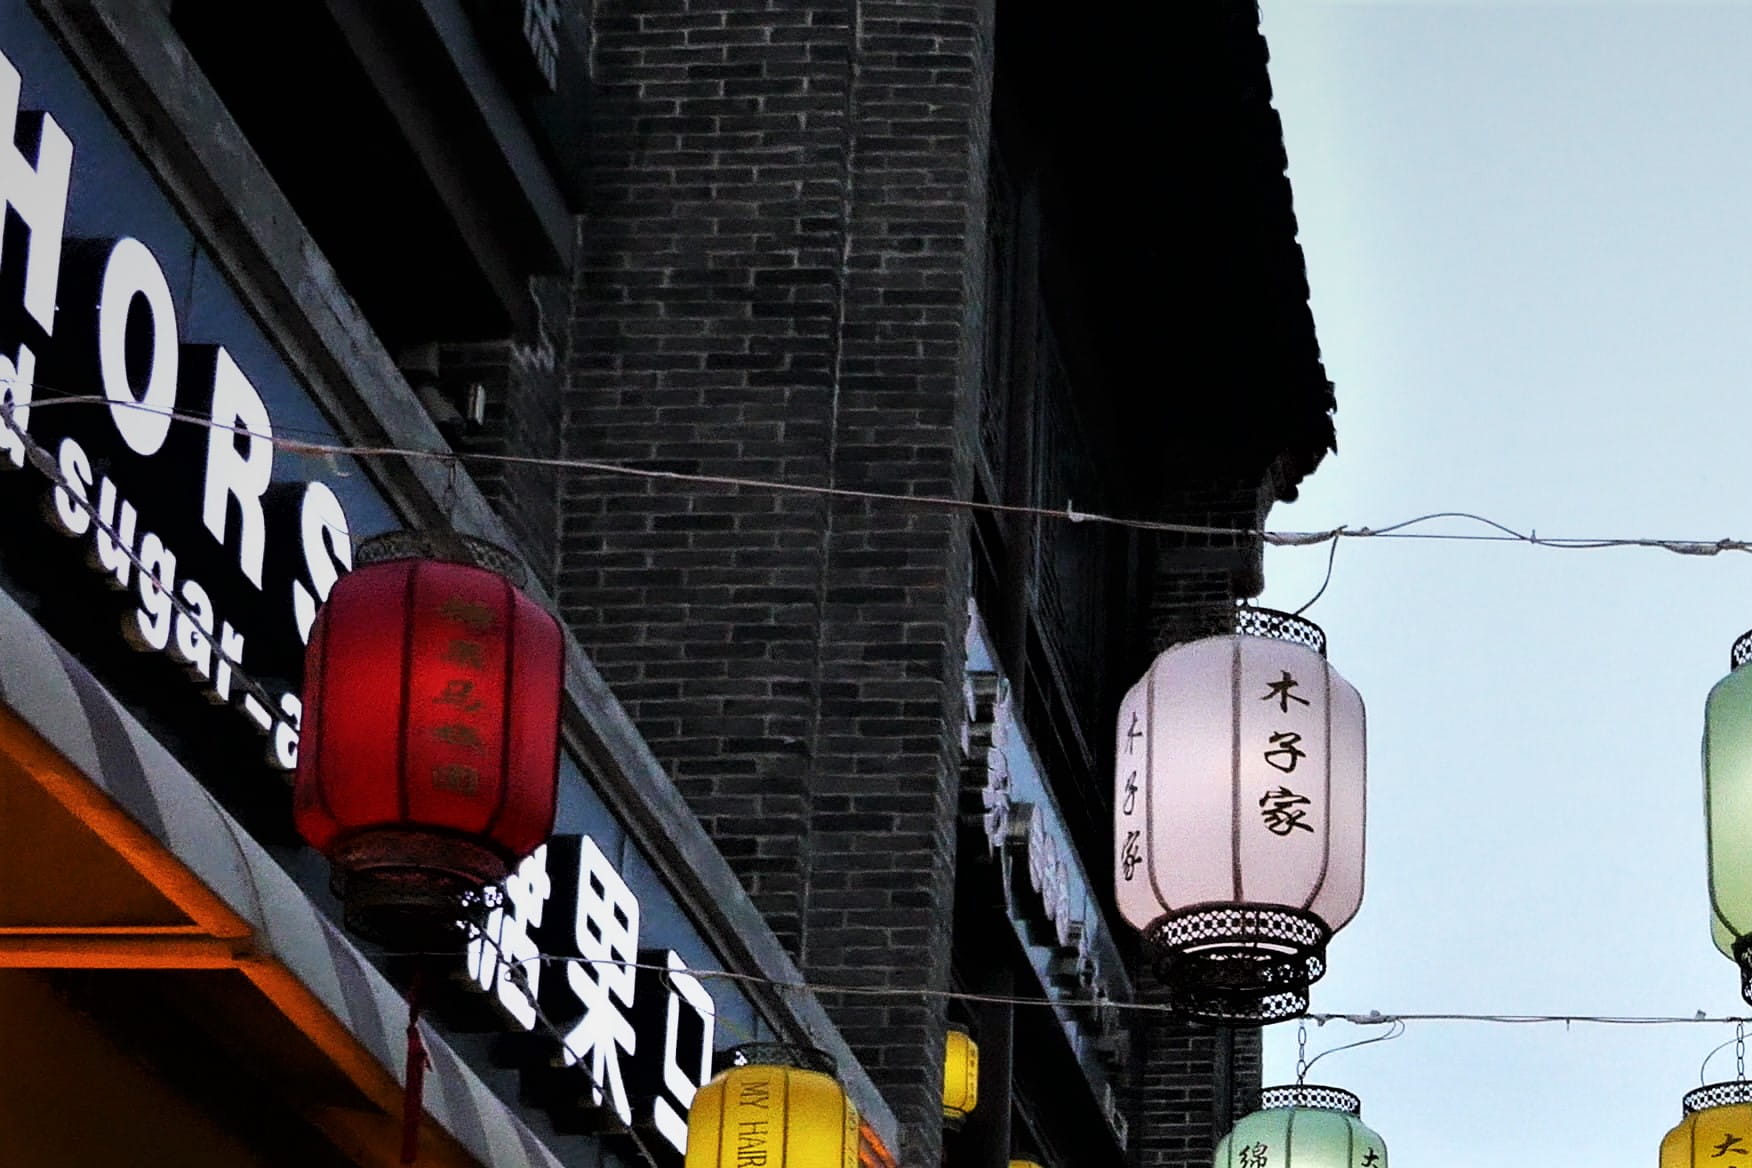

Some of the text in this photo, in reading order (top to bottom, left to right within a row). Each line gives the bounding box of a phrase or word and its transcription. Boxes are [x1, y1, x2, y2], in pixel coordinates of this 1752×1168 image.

[1258, 669, 1314, 836] 木子家
[737, 1121, 769, 1168] HAIR
